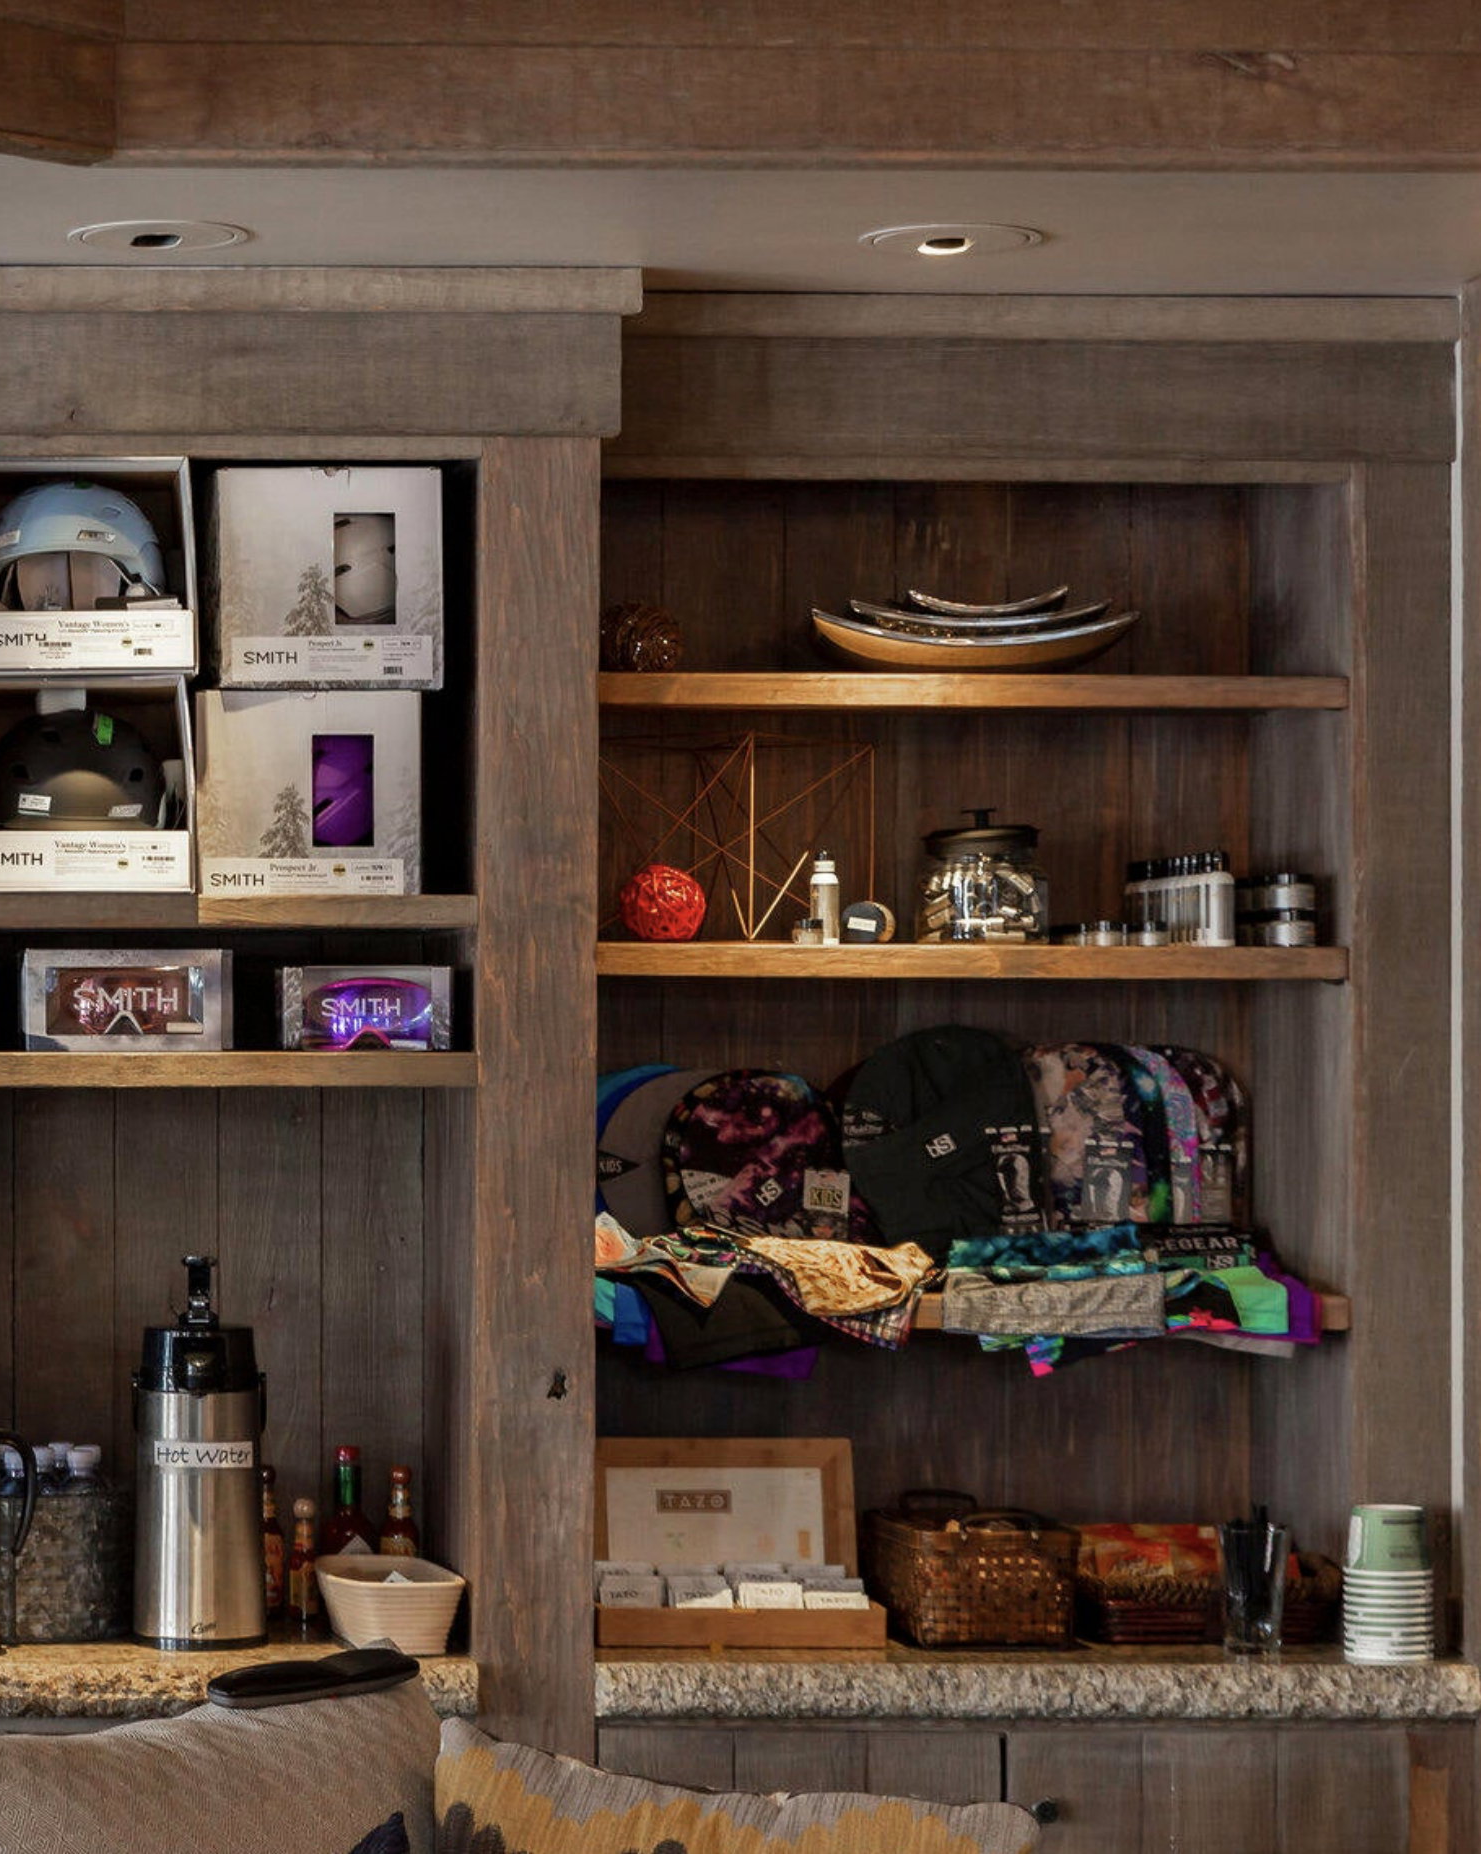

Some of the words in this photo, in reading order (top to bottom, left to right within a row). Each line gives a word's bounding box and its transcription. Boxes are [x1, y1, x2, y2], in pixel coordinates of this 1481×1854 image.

[58, 620, 91, 630] Vantage
[93, 619, 130, 629] Women's
[243, 651, 298, 665] SMITH
[55, 840, 89, 850] Vantage
[90, 840, 126, 849] Women's
[270, 863, 306, 873] Prospect
[210, 872, 265, 887] SMITH
[71, 985, 180, 1013] SMITH
[320, 996, 402, 1018] SMITH
[598, 1159, 623, 1173] KIDS
[809, 1187, 844, 1208] KIDS
[1159, 1235, 1240, 1251] EGEAR
[156, 1446, 190, 1465] Hot
[195, 1446, 253, 1465] Water
[663, 1494, 726, 1509] TAZO
[609, 1590, 639, 1600] TAZO
